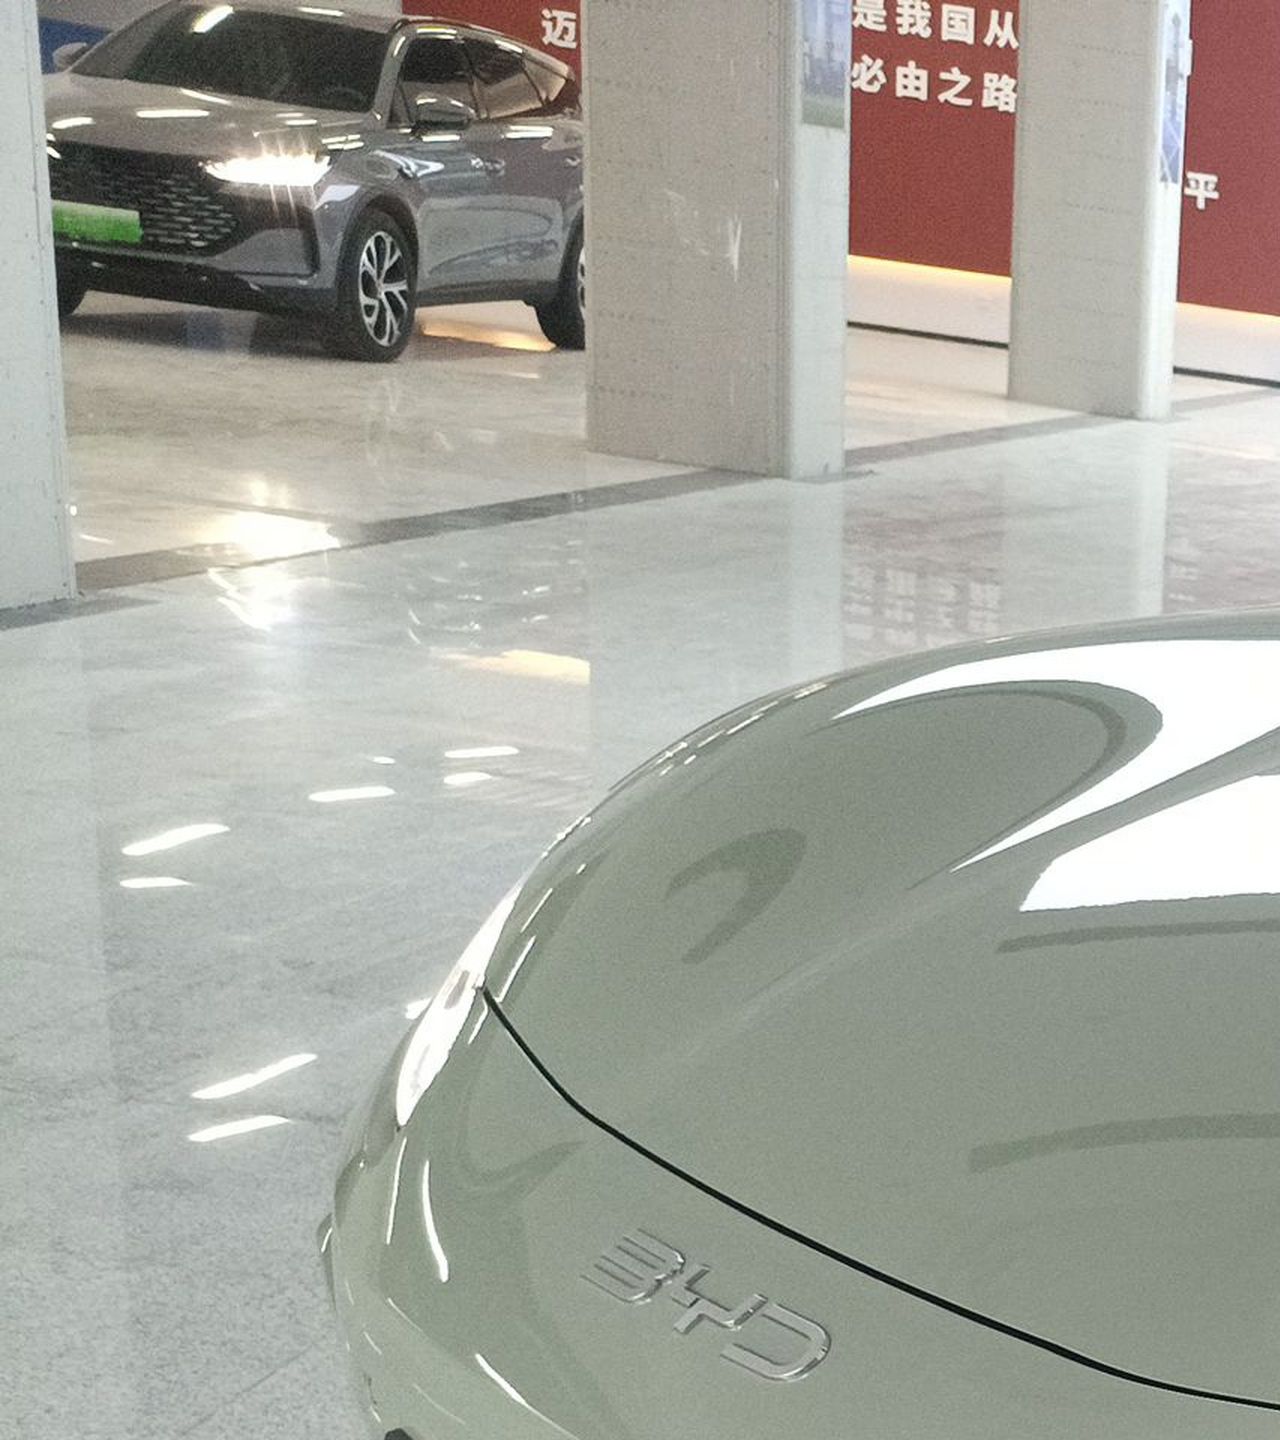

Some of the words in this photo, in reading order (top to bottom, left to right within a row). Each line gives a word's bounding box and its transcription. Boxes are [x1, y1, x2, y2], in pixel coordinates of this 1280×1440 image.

[541, 8, 578, 50] 迈
[851, 54, 1018, 113] 必由之路
[852, 0, 1019, 49] 是我国从
[1184, 171, 1220, 210] 平
[580, 1227, 832, 1381] BYD
